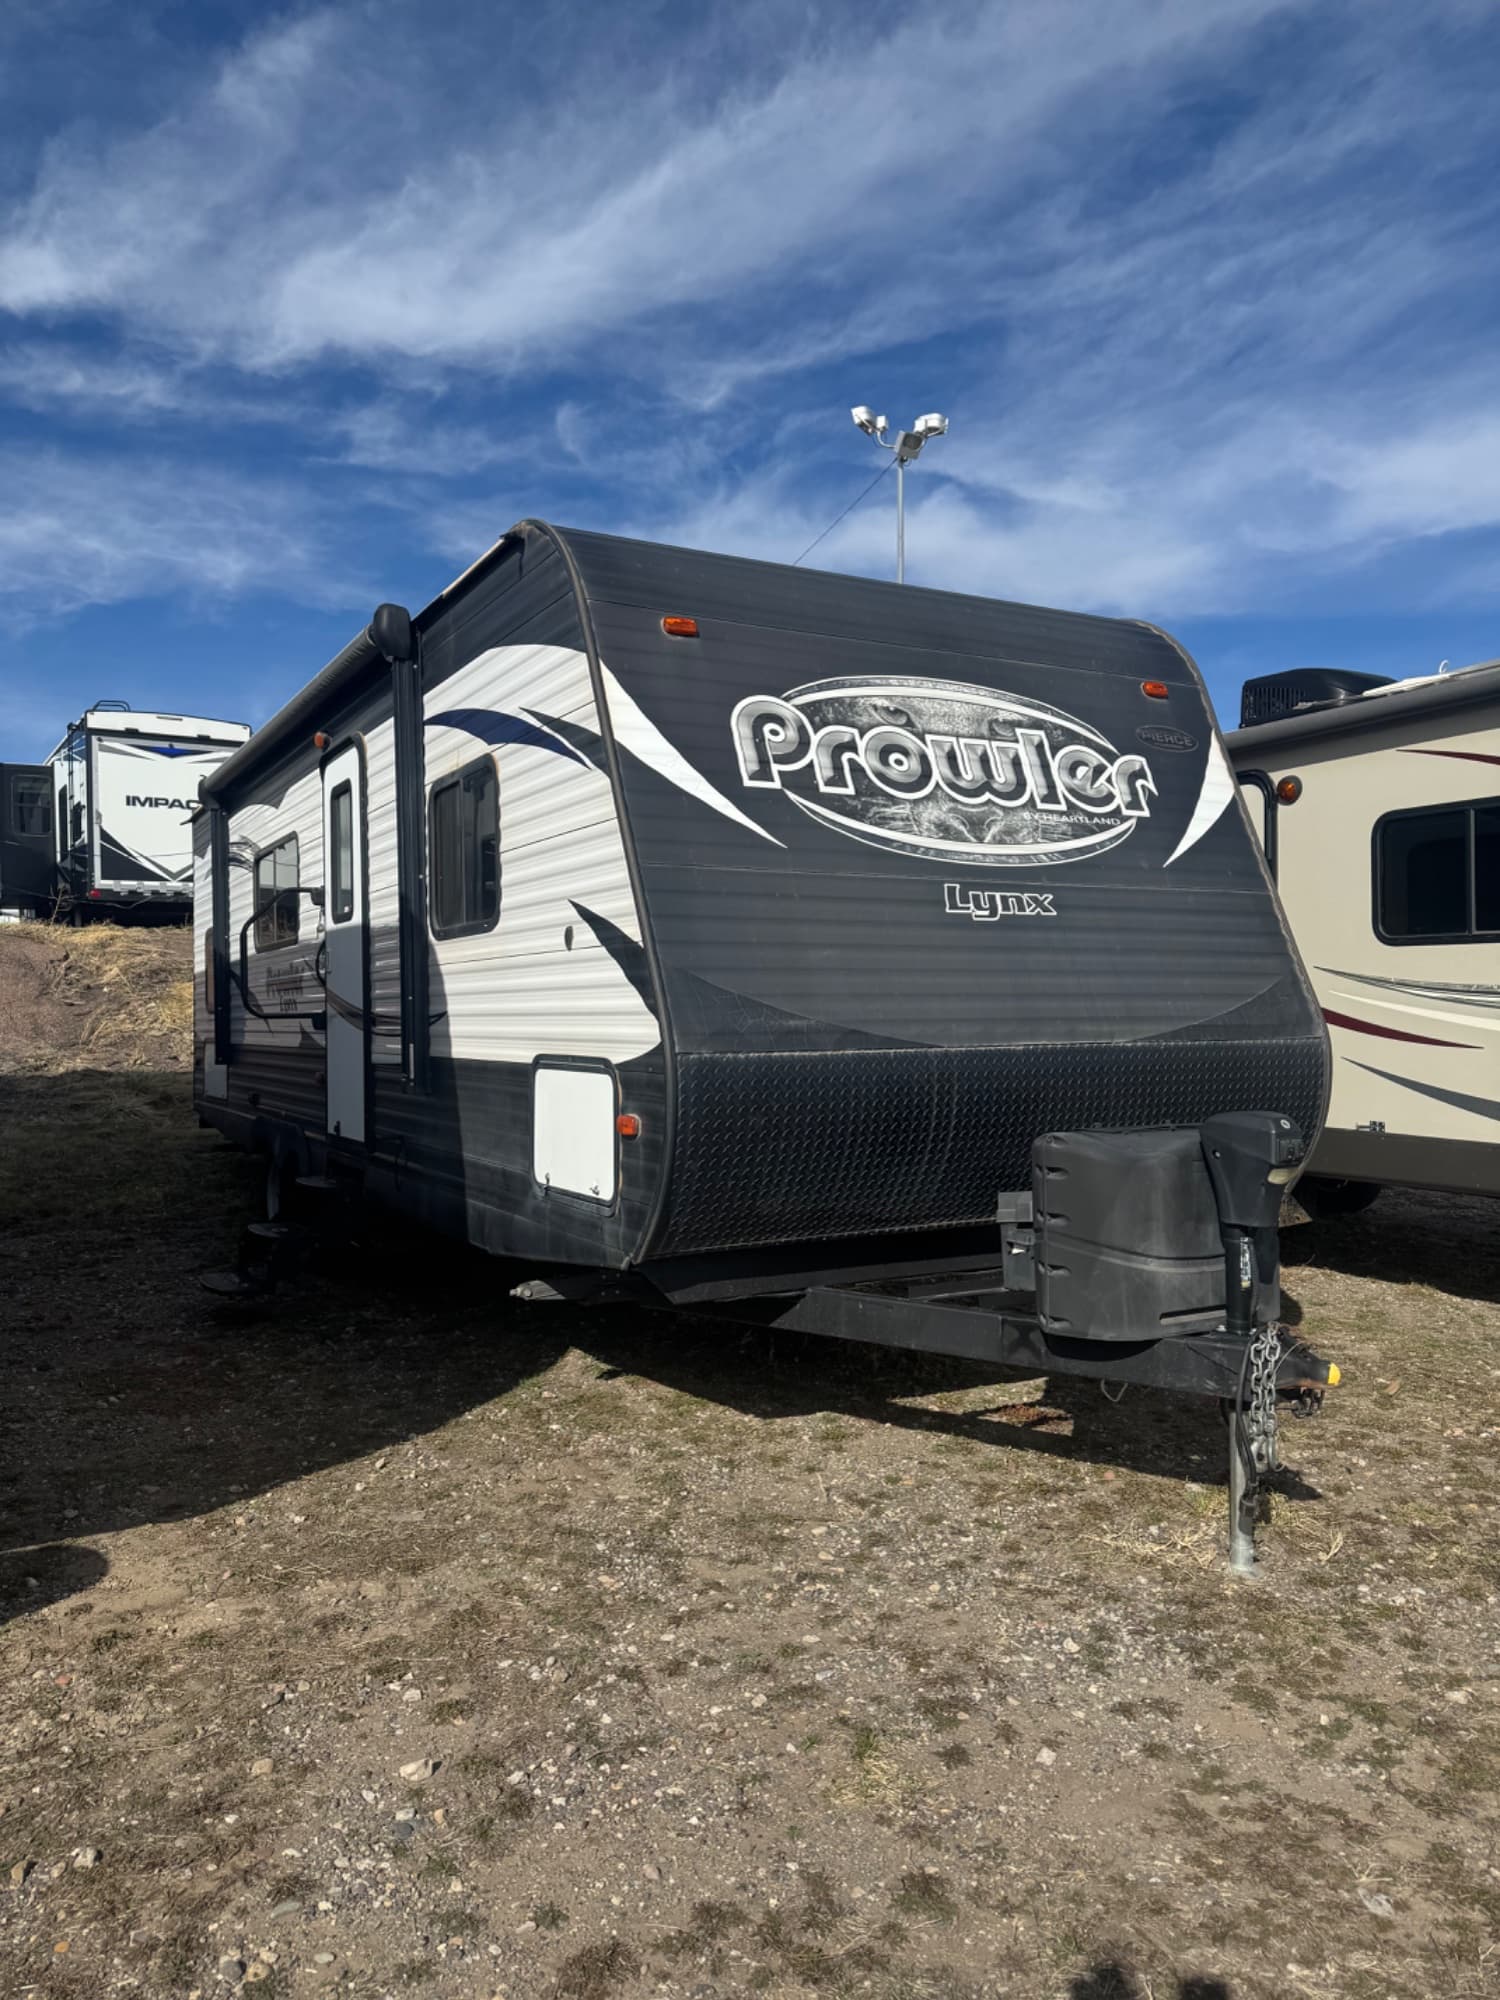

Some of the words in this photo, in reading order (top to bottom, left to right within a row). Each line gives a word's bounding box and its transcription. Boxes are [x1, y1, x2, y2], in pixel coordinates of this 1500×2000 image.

[731, 695, 1158, 817] Prowler
[1038, 812, 1121, 826] HEARTLAND
[944, 883, 1057, 921] Lynx
